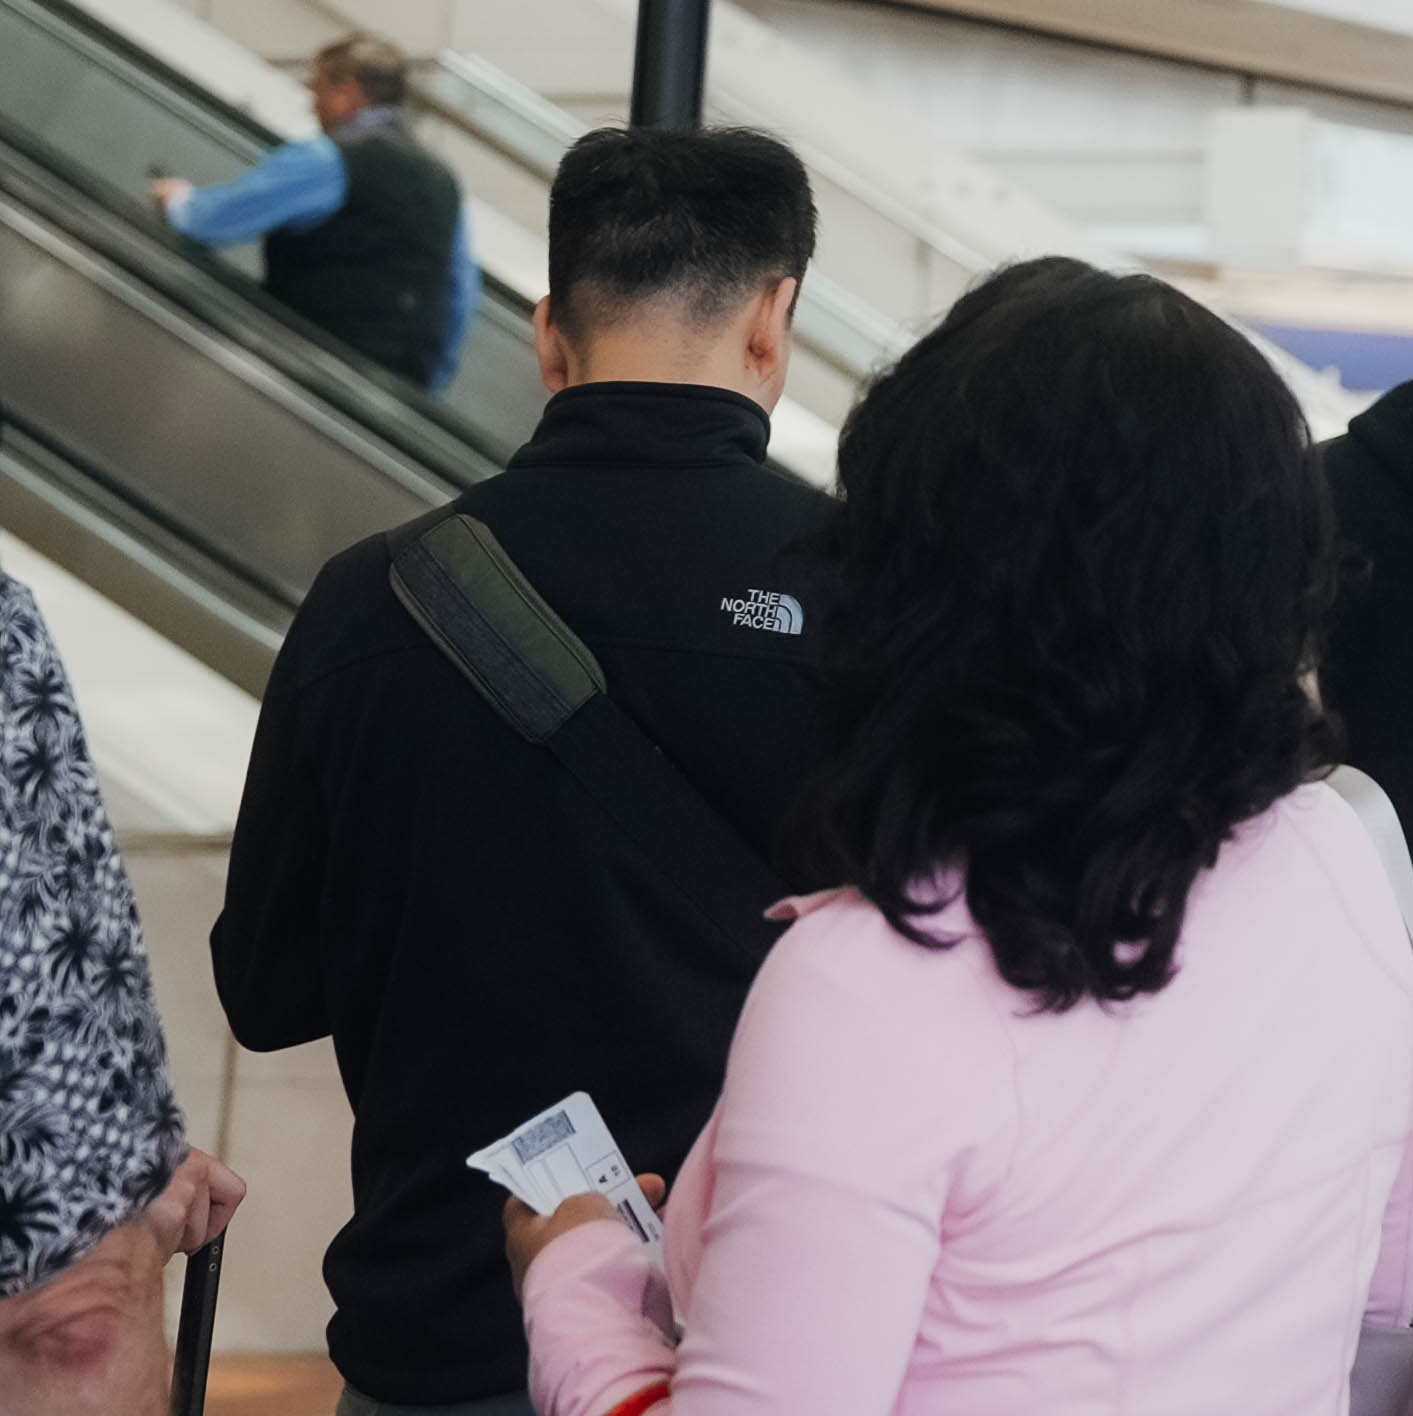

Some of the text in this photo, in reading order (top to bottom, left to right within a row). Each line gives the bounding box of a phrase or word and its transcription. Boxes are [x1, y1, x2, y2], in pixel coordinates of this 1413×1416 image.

[747, 588, 780, 604] THE
[720, 597, 777, 618] NORTH
[733, 613, 777, 631] FACE
